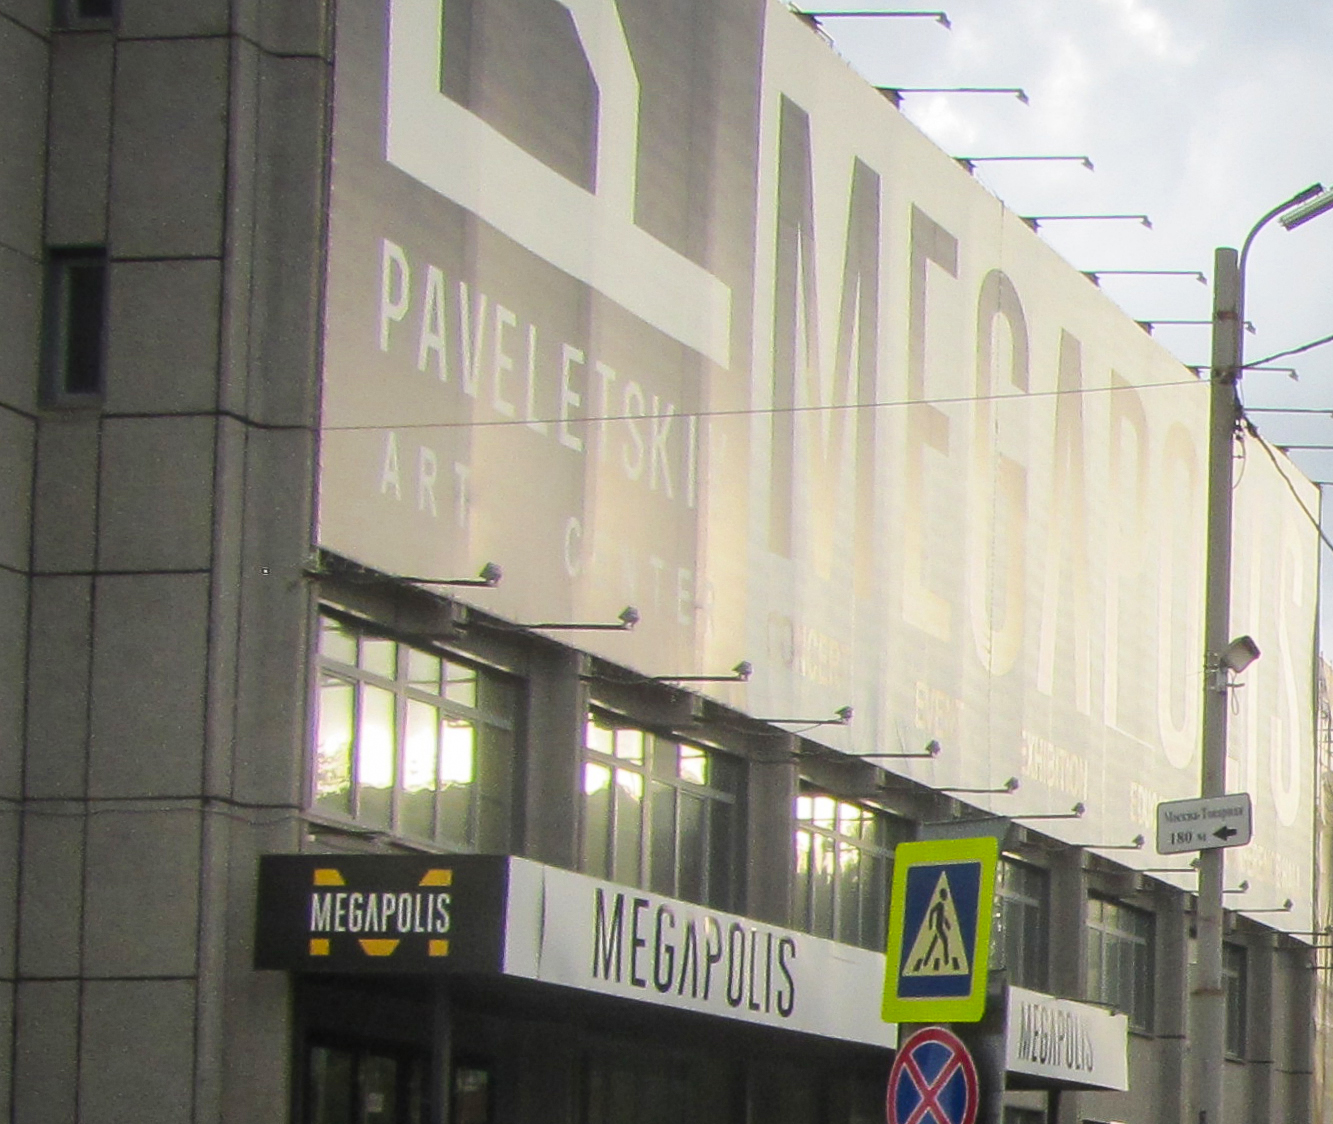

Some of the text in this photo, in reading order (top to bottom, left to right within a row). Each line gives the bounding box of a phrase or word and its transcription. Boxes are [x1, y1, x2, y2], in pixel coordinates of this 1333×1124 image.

[379, 430, 716, 634] ART CNTER
[1170, 830, 1192, 845] 180
[310, 892, 451, 933] MEGAPOLIS
[592, 887, 797, 1018] MEGAPOLIS
[1018, 1001, 1095, 1073] MEGAPOLIS
